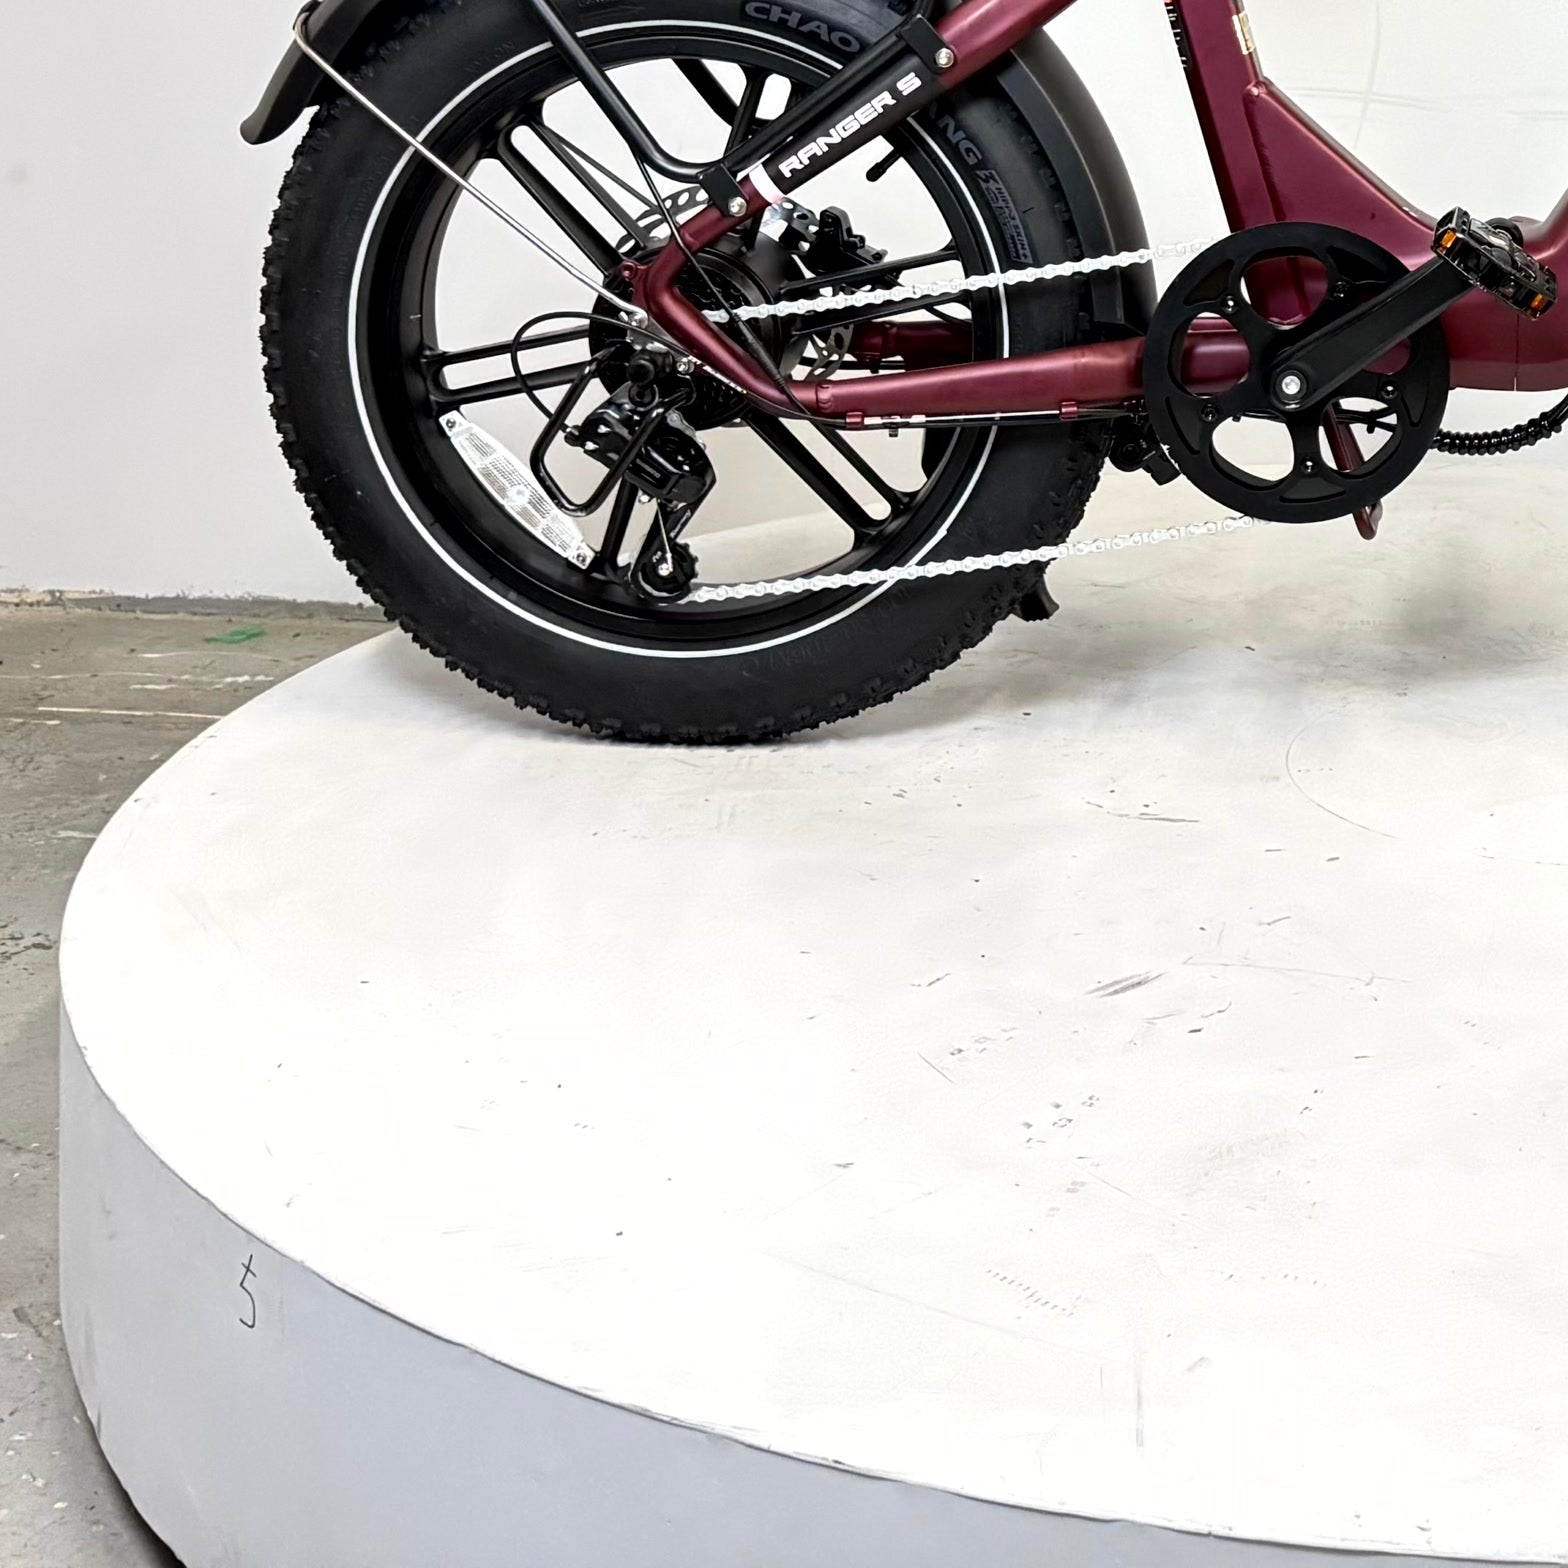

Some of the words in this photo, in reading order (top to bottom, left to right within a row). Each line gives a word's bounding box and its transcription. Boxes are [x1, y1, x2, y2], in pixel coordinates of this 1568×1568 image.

[744, 0, 861, 53] CHAO
[777, 90, 898, 178] RANGER
[895, 71, 922, 96] S
